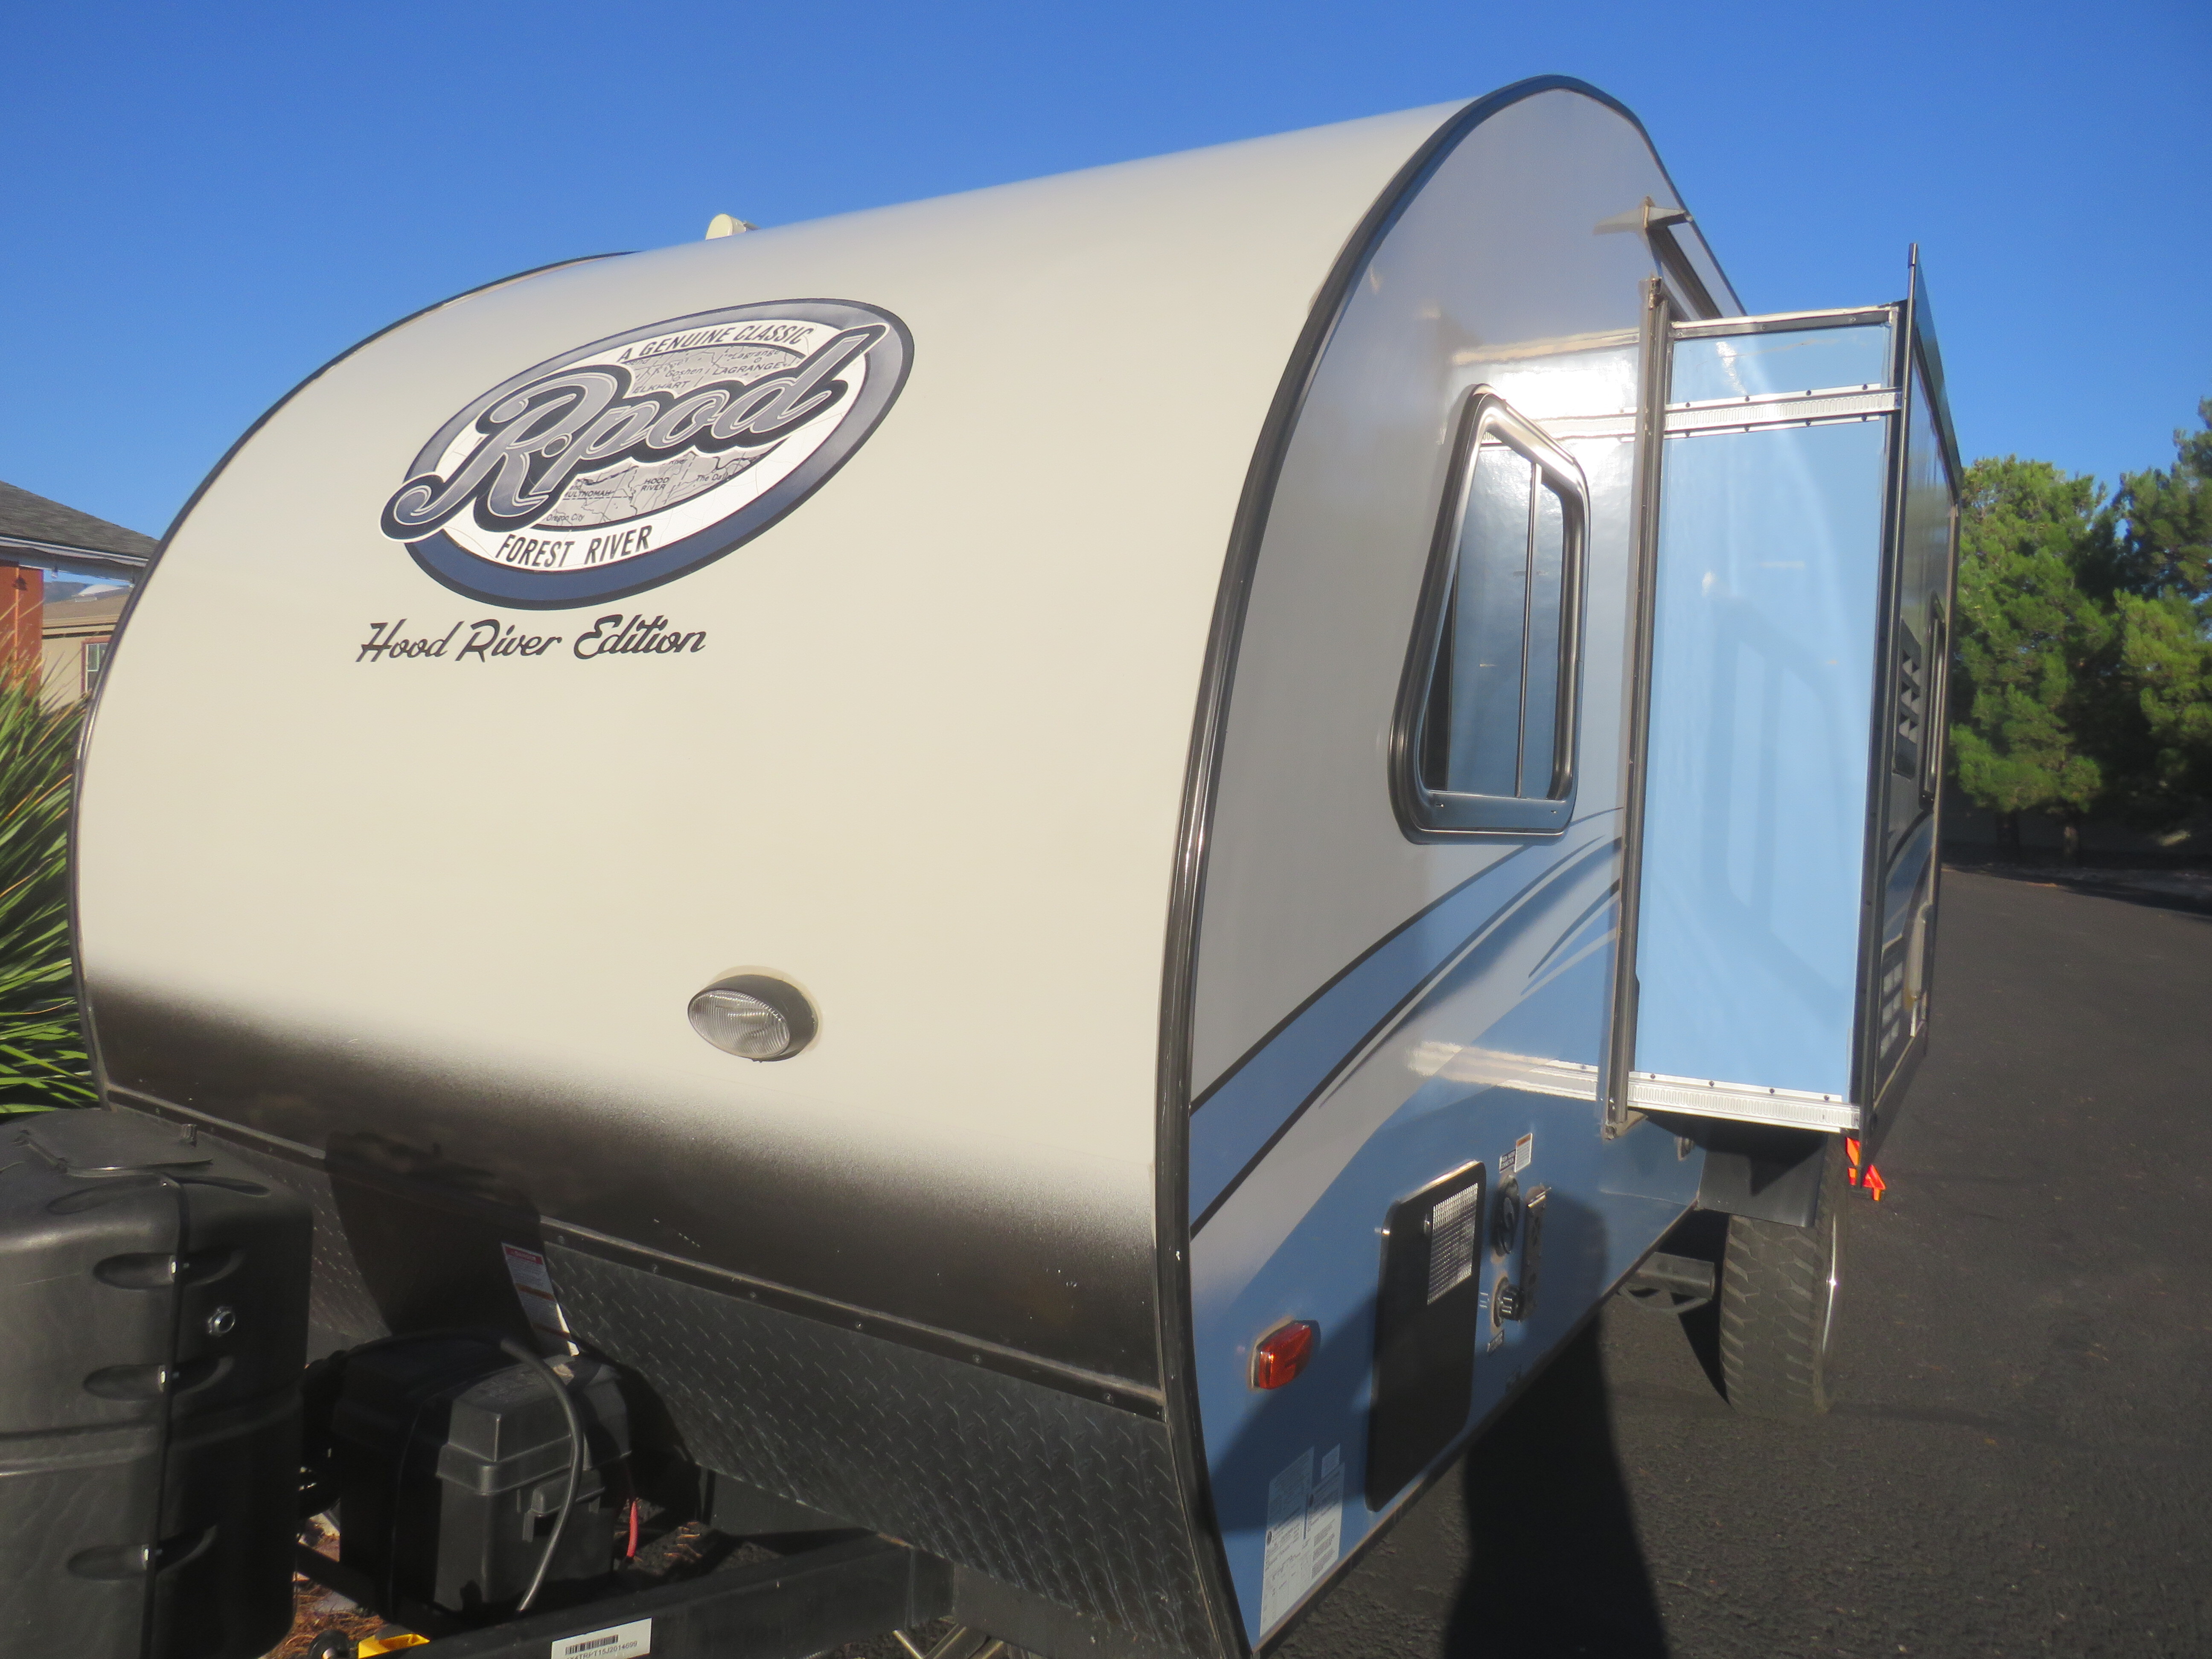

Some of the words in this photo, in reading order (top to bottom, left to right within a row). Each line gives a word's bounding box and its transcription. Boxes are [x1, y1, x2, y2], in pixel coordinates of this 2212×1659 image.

[616, 347, 633, 363] A
[639, 327, 736, 357] GENUINE
[733, 325, 814, 345] CLASSIC
[731, 349, 780, 359] Lagrange
[665, 367, 704, 378] Goshen
[712, 362, 784, 375] LAGRANGE
[632, 380, 691, 393] ELKHART
[546, 513, 569, 523] Oregon
[570, 513, 585, 522] City
[495, 533, 575, 568] FOREST
[584, 525, 652, 565] RIVER
[355, 618, 465, 662] Hood
[455, 619, 562, 663] River
[573, 614, 706, 660] Edition
[567, 1640, 638, 1659] 4TRPT15J2014699
